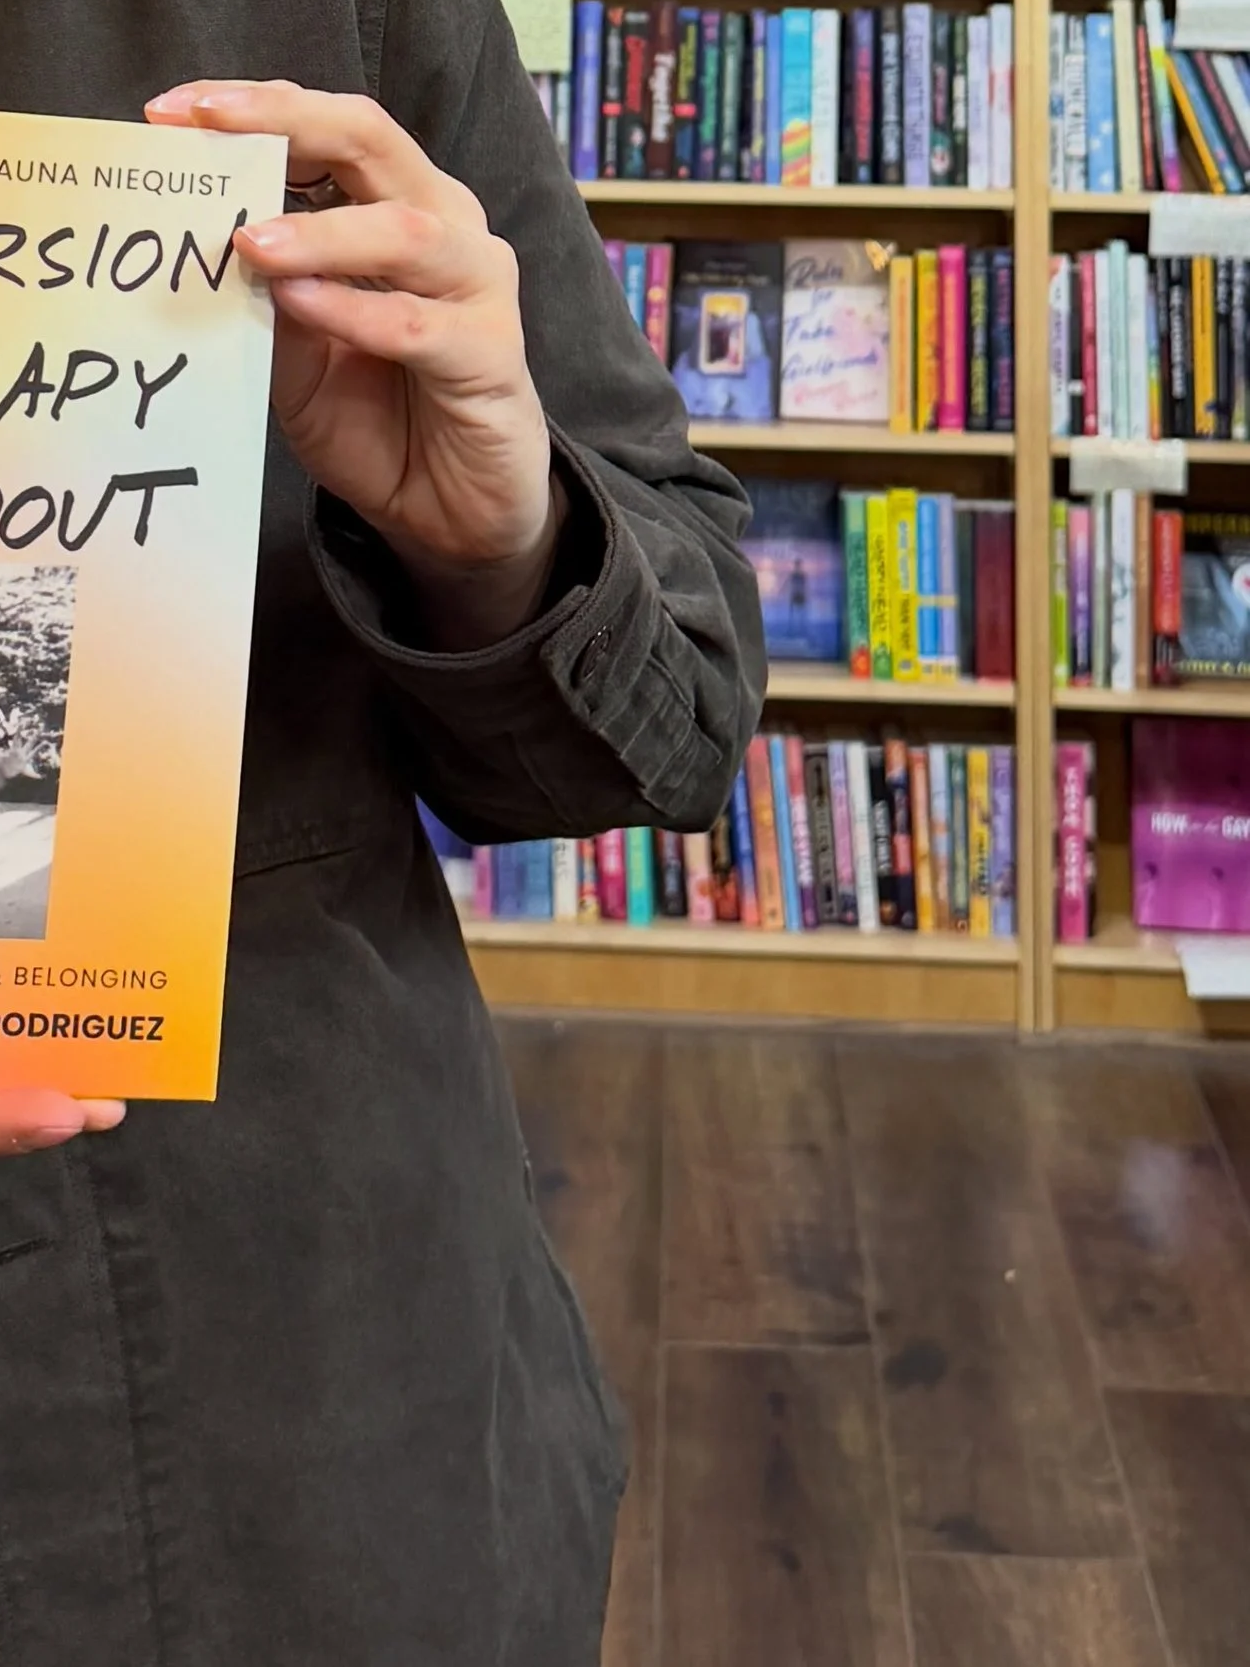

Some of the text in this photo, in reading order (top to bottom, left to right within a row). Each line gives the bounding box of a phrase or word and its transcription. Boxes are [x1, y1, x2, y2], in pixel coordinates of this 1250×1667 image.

[94, 167, 232, 198] NIEQUIST
[1152, 812, 1189, 835] HOW
[13, 967, 169, 990] BELONGING
